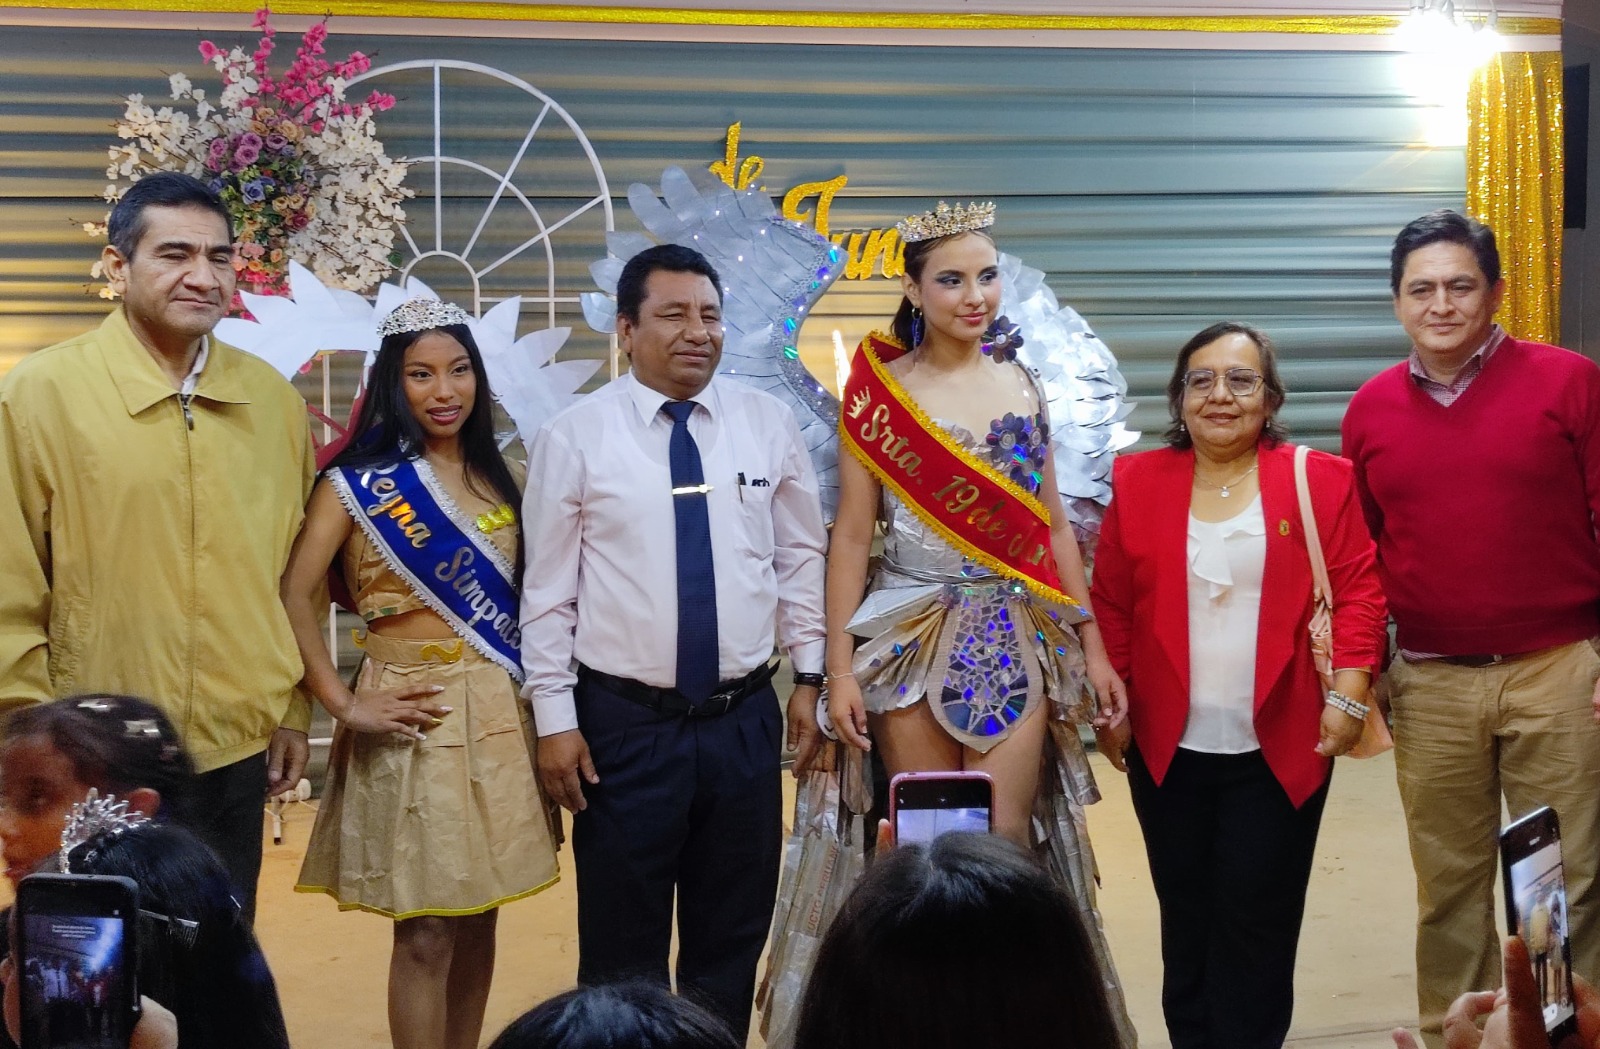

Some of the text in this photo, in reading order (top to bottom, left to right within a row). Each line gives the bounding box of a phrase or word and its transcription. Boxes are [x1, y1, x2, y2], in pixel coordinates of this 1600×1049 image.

[782, 174, 906, 280] Jun
[860, 404, 923, 486] Srta.
[932, 475, 980, 514] 19
[966, 501, 1007, 541] de
